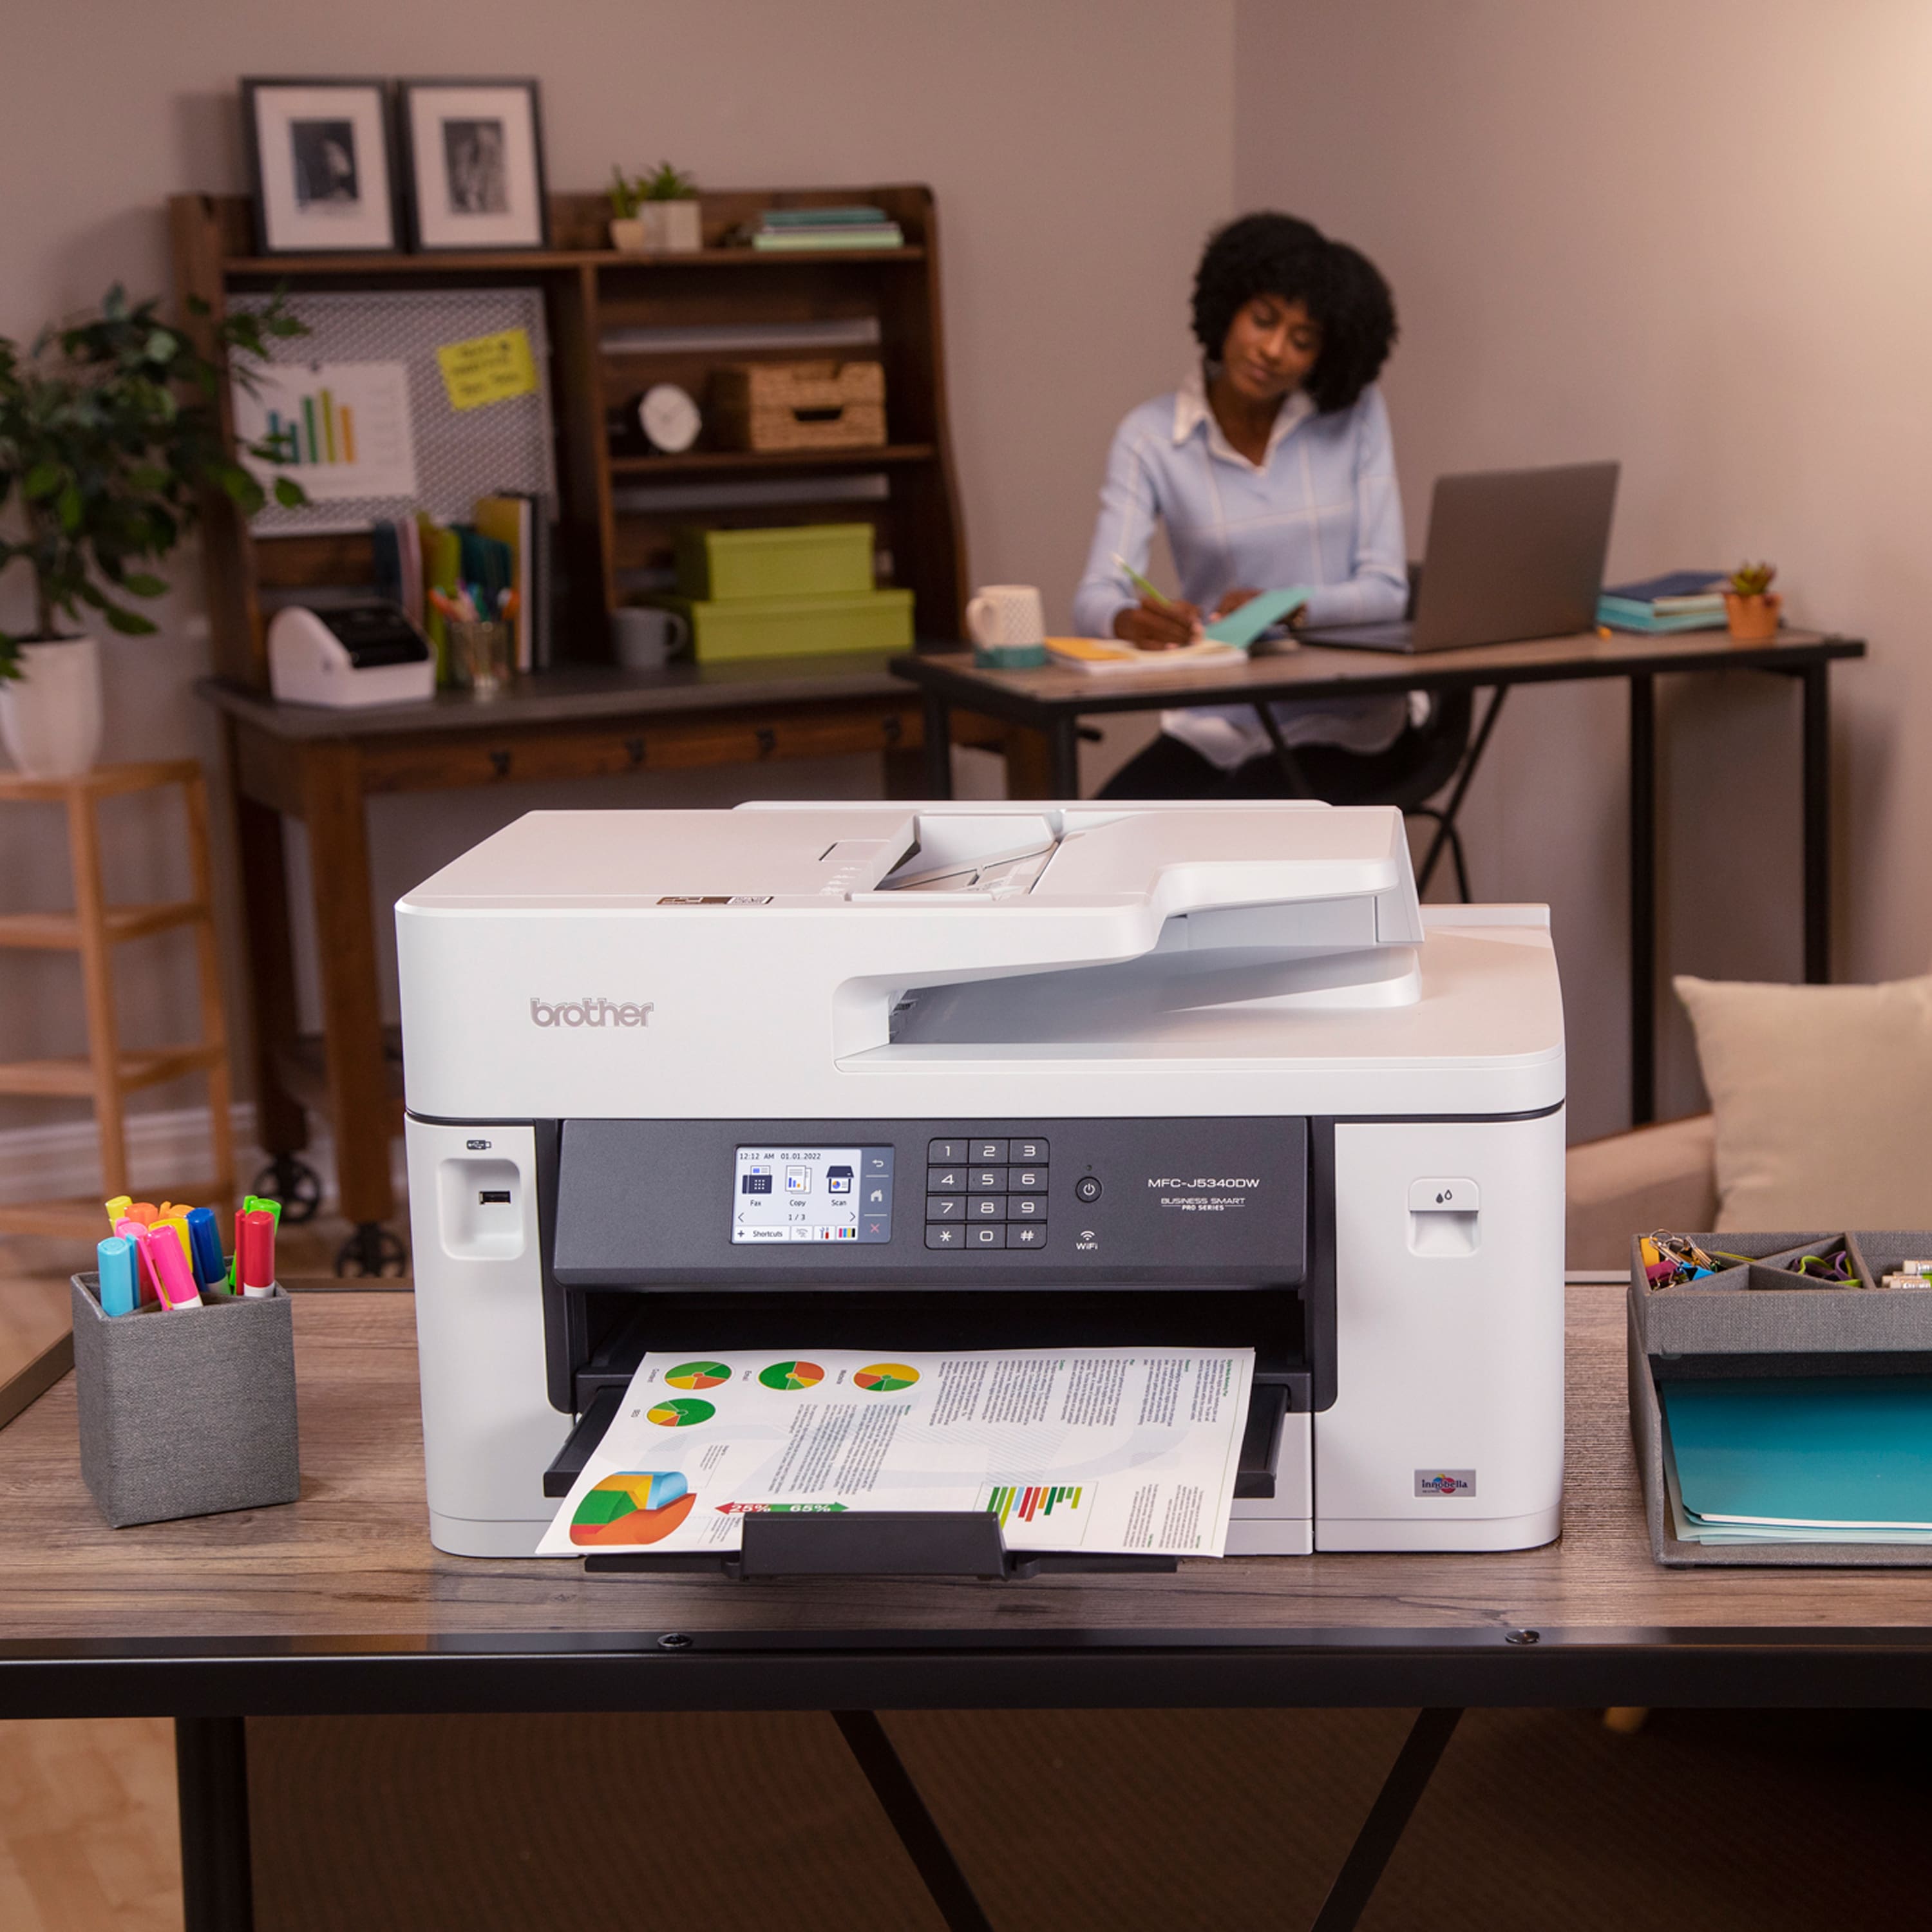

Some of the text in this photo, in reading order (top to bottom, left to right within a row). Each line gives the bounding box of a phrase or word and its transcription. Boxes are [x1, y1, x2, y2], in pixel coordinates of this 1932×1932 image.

[530, 998, 654, 1027] brother
[945, 1145, 1036, 1157] 1 2 3
[941, 1173, 1035, 1185] 4 5 6
[1148, 1179, 1260, 1188] MFC-J5340DW
[790, 1200, 806, 1208] Copy
[941, 1202, 1035, 1213] 7 8 9
[980, 1231, 994, 1242] 0
